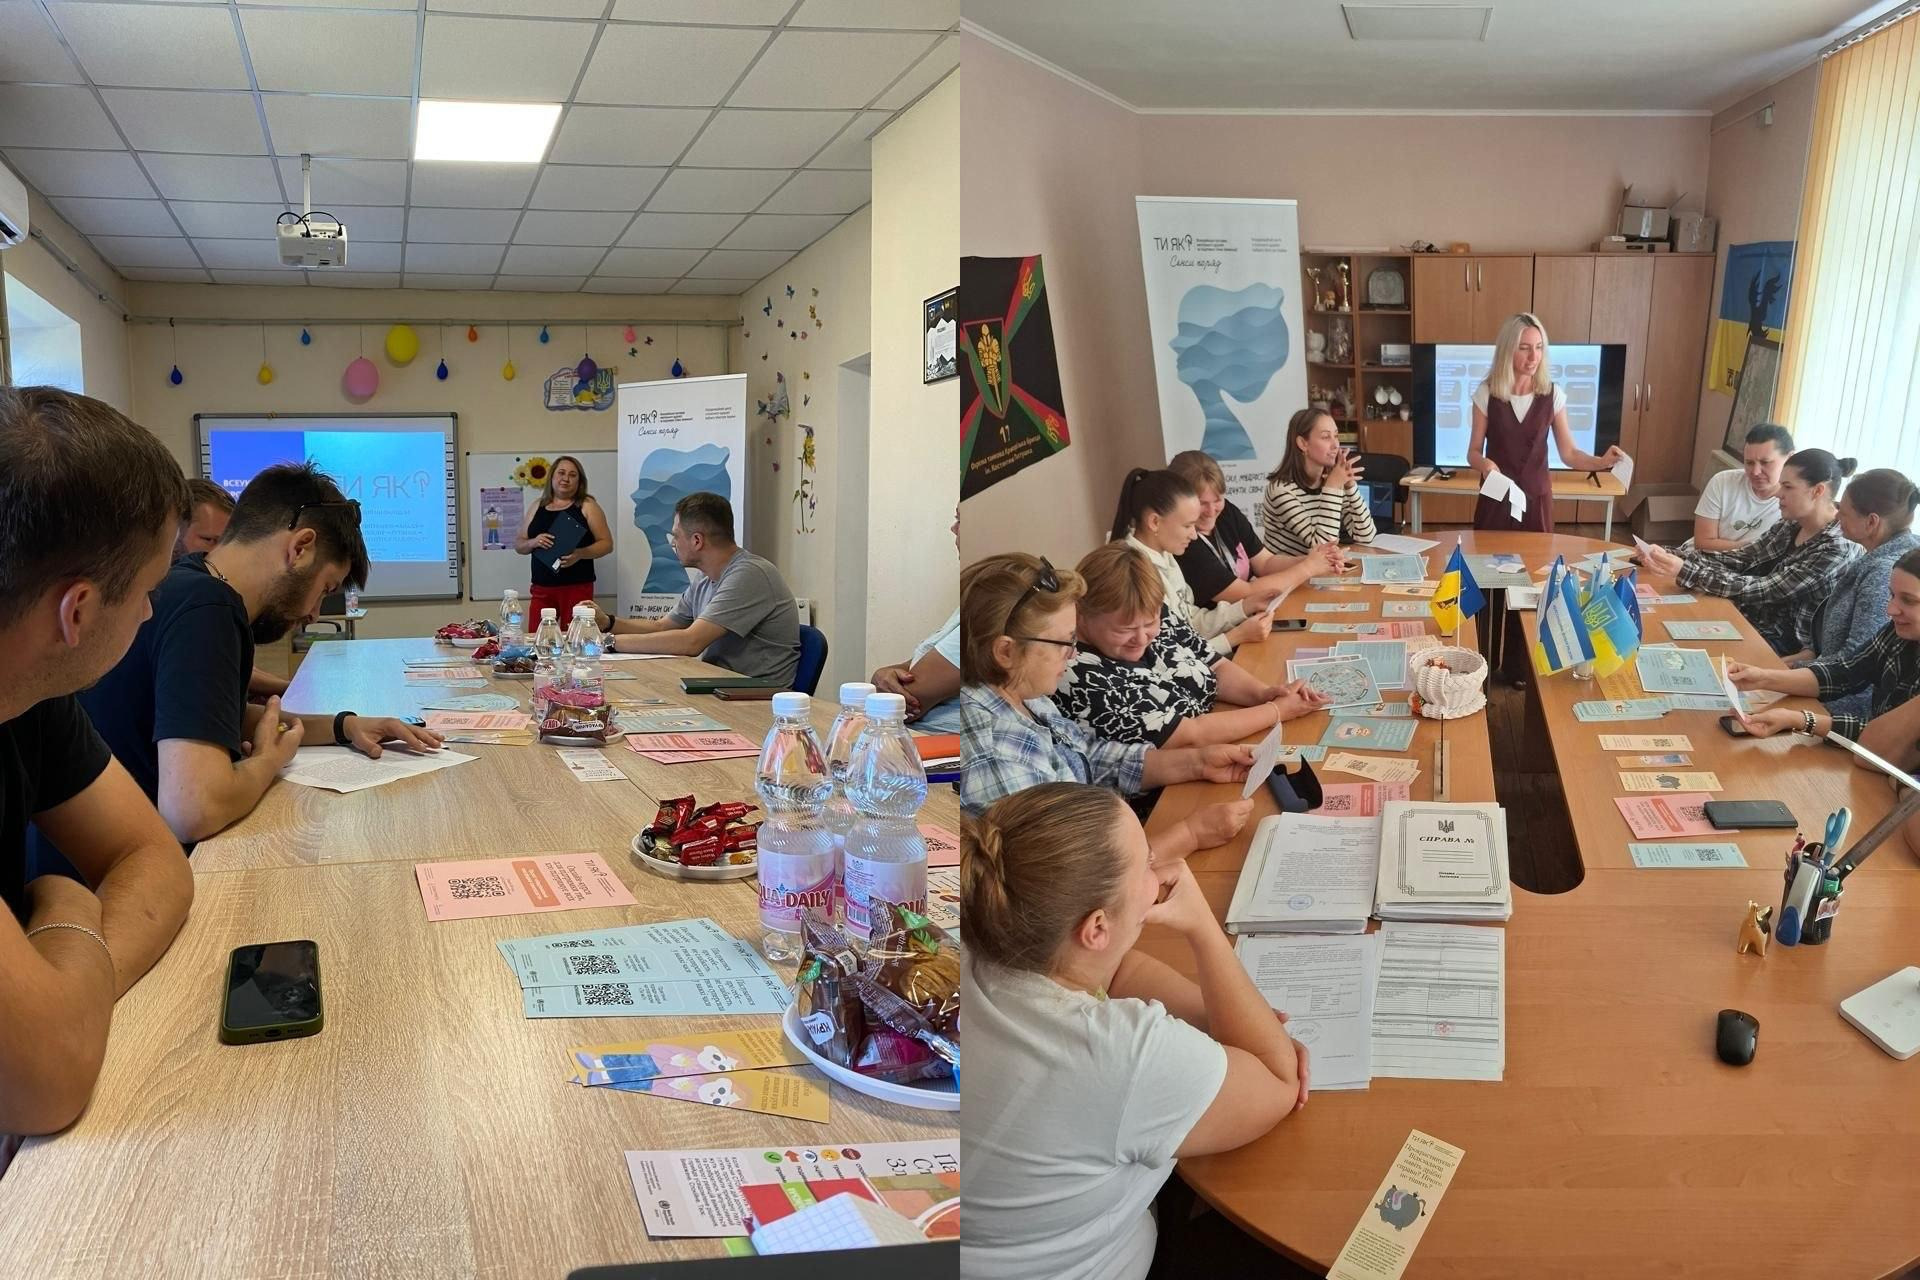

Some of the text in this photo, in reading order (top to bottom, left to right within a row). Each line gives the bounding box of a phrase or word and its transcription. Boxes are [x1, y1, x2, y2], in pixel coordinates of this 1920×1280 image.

[1153, 237, 1168, 251] ТИ
[1170, 234, 1193, 251] ЯК?
[627, 414, 639, 425] ТИ
[640, 409, 657, 425] ЯК?
[785, 889, 832, 909] DAILY
